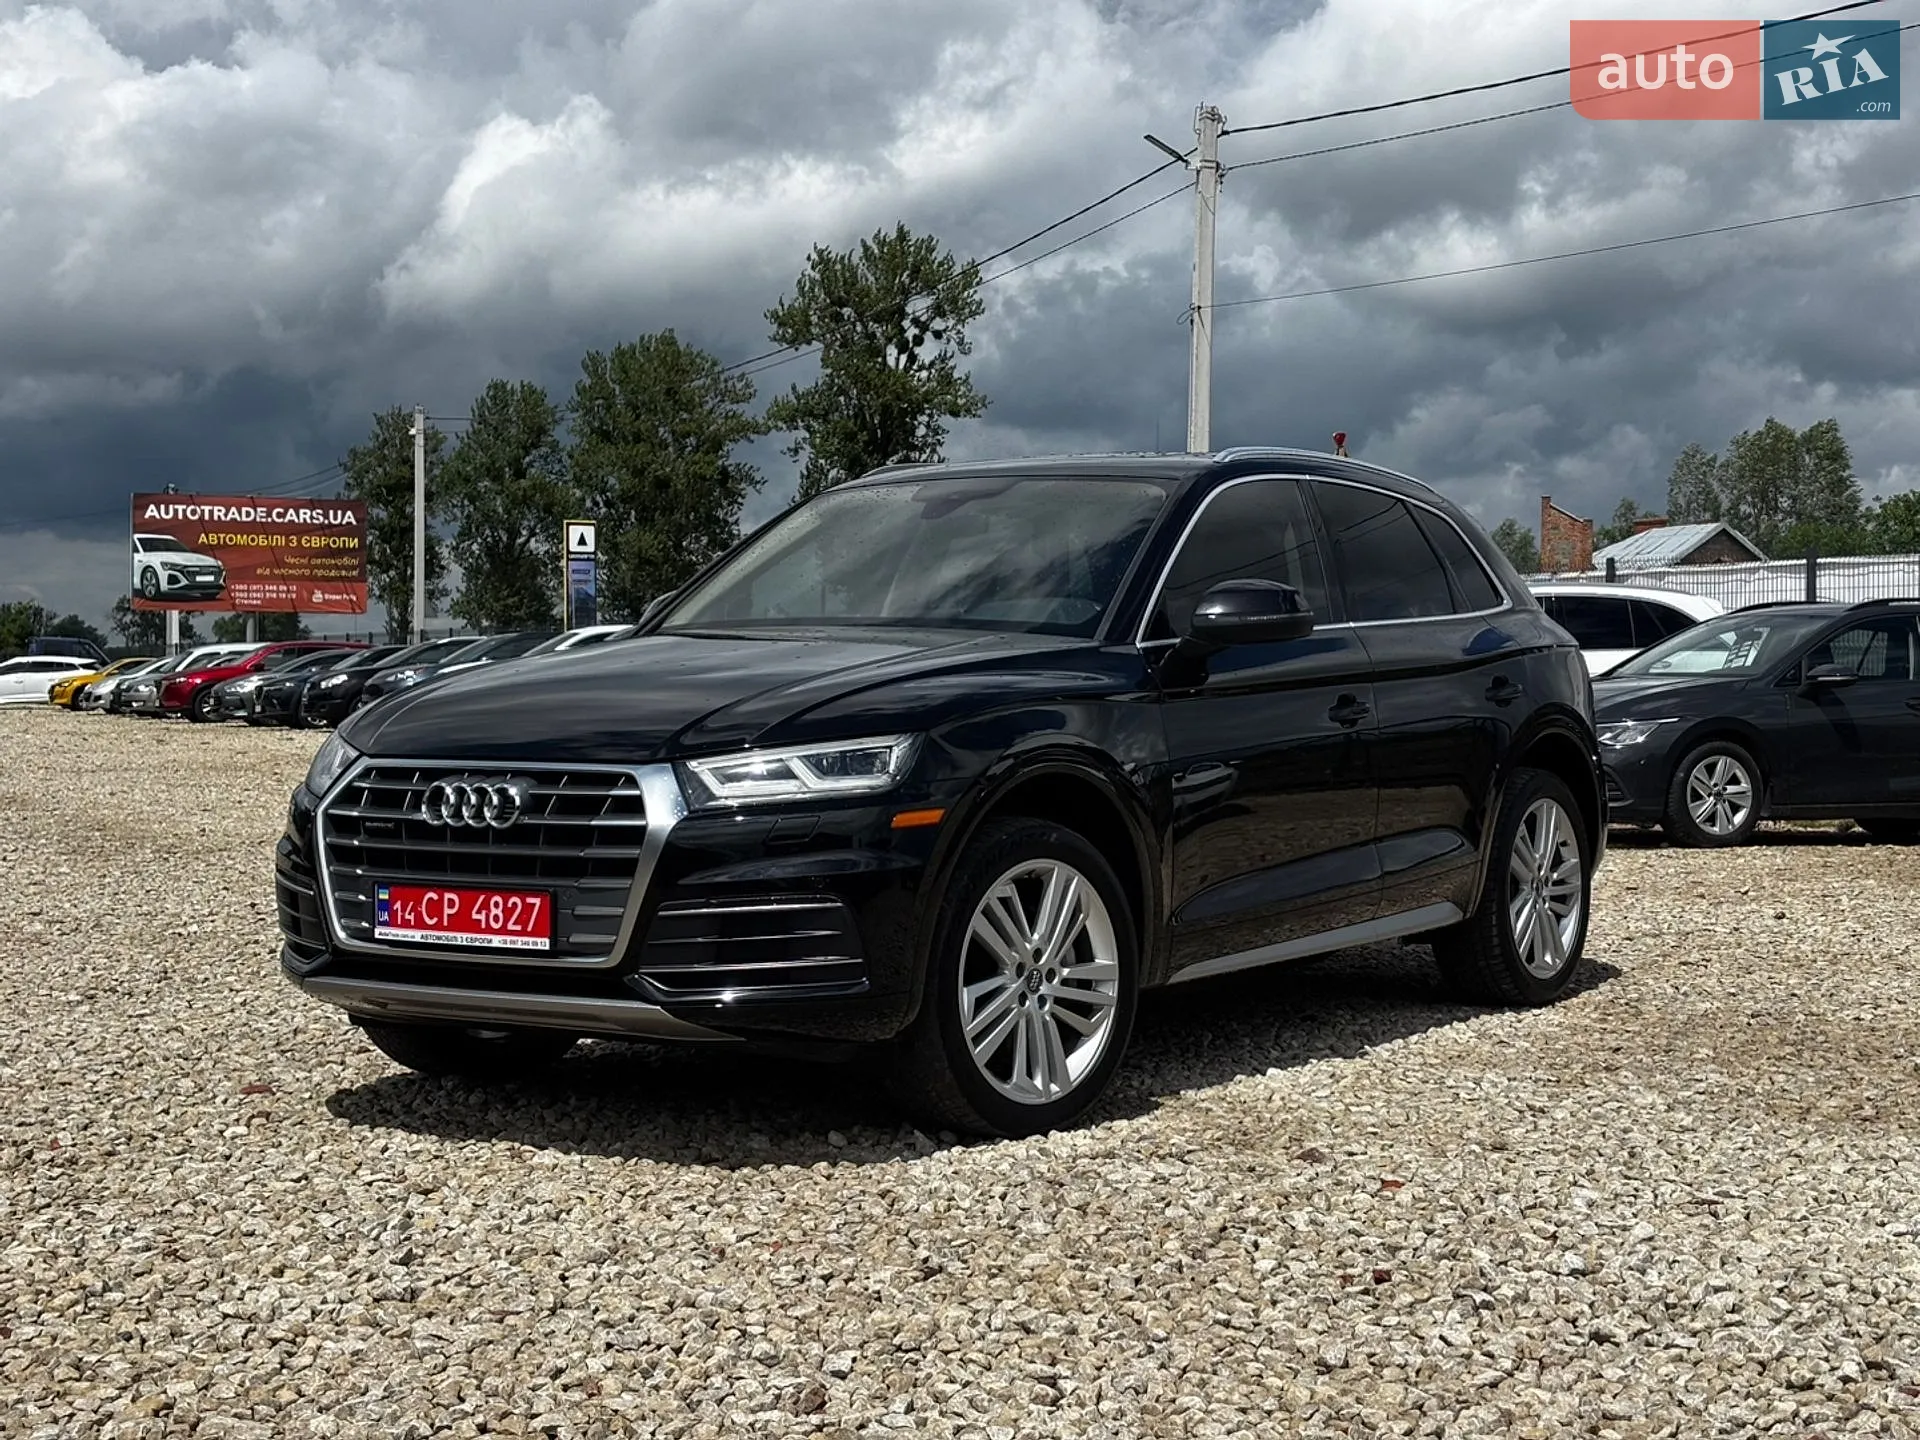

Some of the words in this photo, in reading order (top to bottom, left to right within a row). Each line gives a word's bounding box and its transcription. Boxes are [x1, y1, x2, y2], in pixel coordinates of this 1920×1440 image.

[144, 503, 357, 525] AUTOTRADE.CARS.UA
[198, 533, 285, 547] АВТОМОБІЛІ
[289, 535, 298, 547] З
[301, 536, 359, 548] ЄВРОПИ
[284, 555, 309, 565] Чесні
[310, 556, 359, 565] автомобілі
[256, 566, 270, 576] від
[273, 567, 310, 576] чесного
[378, 910, 389, 922] UA
[472, 894, 542, 932] 4827
